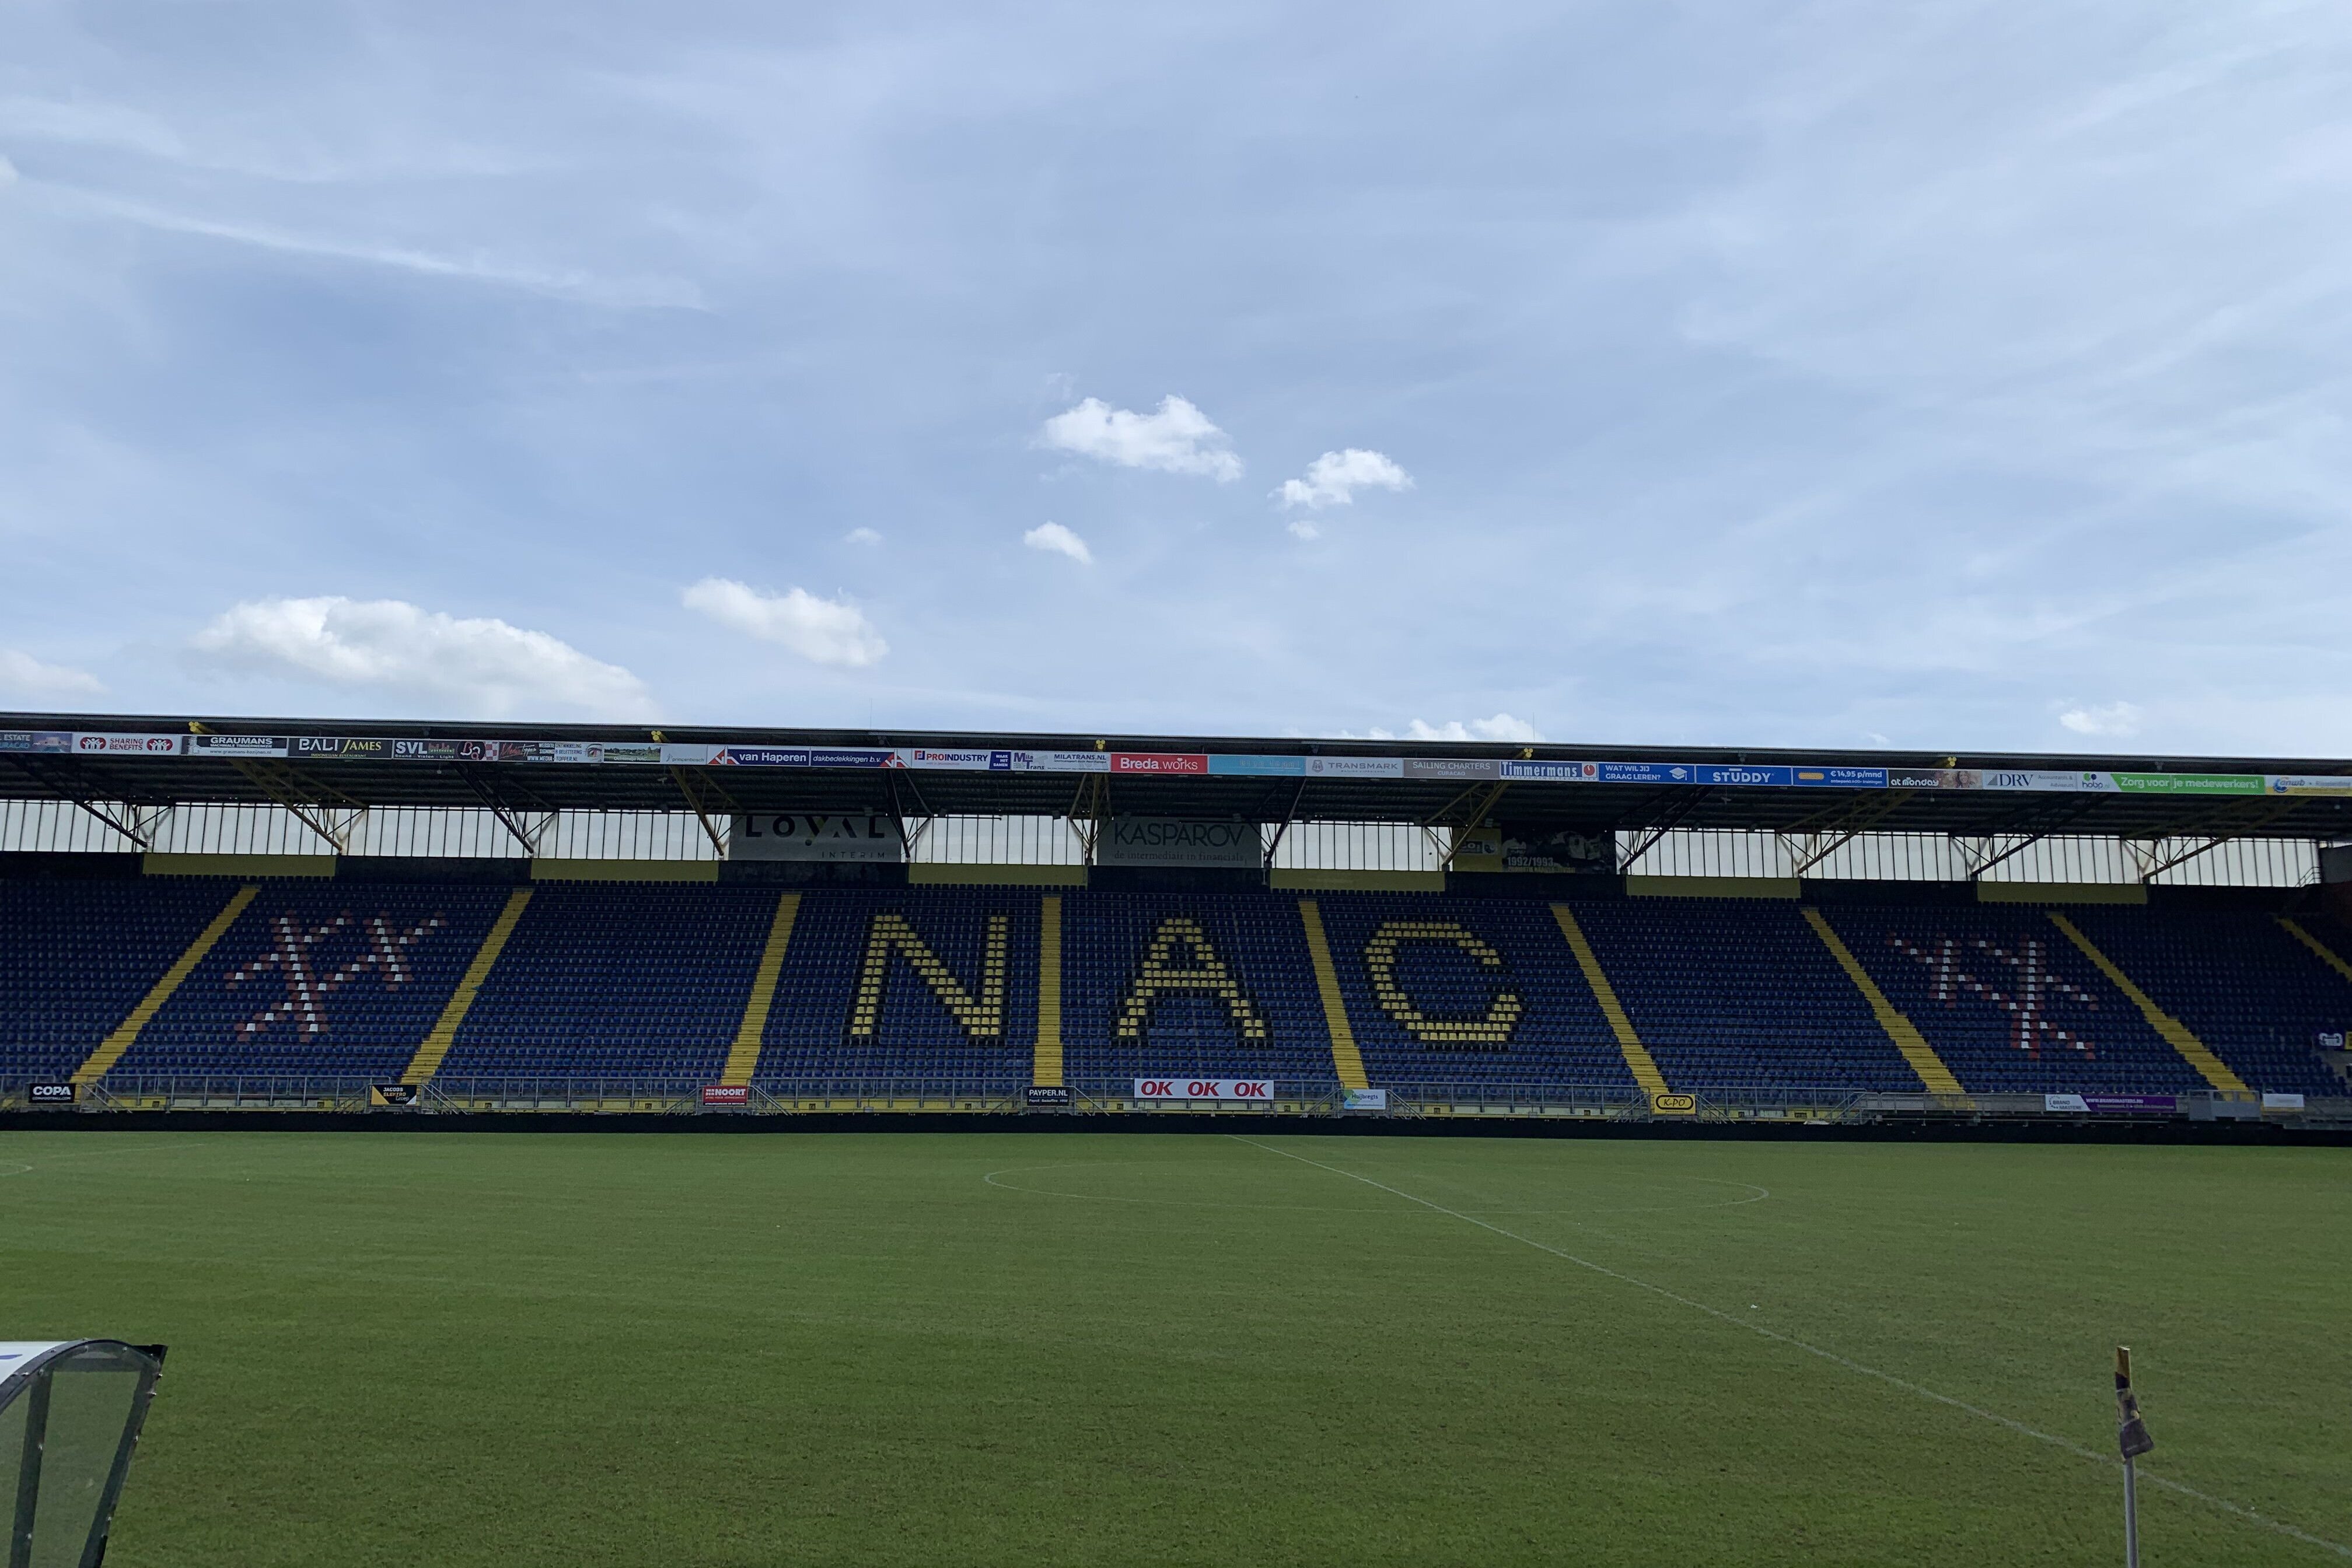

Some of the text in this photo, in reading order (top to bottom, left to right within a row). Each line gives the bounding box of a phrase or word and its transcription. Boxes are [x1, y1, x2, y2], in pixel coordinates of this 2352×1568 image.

[210, 737, 273, 745] GRAUMANS
[299, 738, 382, 754] BALI JAMES
[395, 741, 428, 755] SVL
[739, 752, 807, 763] van Haperen
[813, 755, 869, 764] dakbedekkingen
[926, 754, 988, 762] PROINDUSTRY
[1328, 762, 1399, 770] TRANSMARK
[1412, 761, 1491, 771] SAILING CHARTERS
[1501, 761, 1578, 777] Timmermans
[1713, 769, 1771, 783] STUDDY
[1857, 770, 1882, 779] p/mnd
[1902, 777, 1939, 787] monday
[1999, 774, 2034, 787] DRV
[2121, 776, 2145, 789] Zorg
[2147, 779, 2169, 787] voor
[2173, 778, 2183, 789] je
[1114, 822, 1245, 846] KASPAROV
[822, 851, 885, 859] INTERIM
[1114, 850, 1244, 862] de intermediair in financials
[1507, 856, 1554, 867] 1992/1993
[33, 1086, 71, 1096] COPA
[715, 1088, 746, 1096] NOORT
[1141, 1080, 1267, 1097] OK OK OK
[1351, 1093, 1379, 1101] Huijbregts
